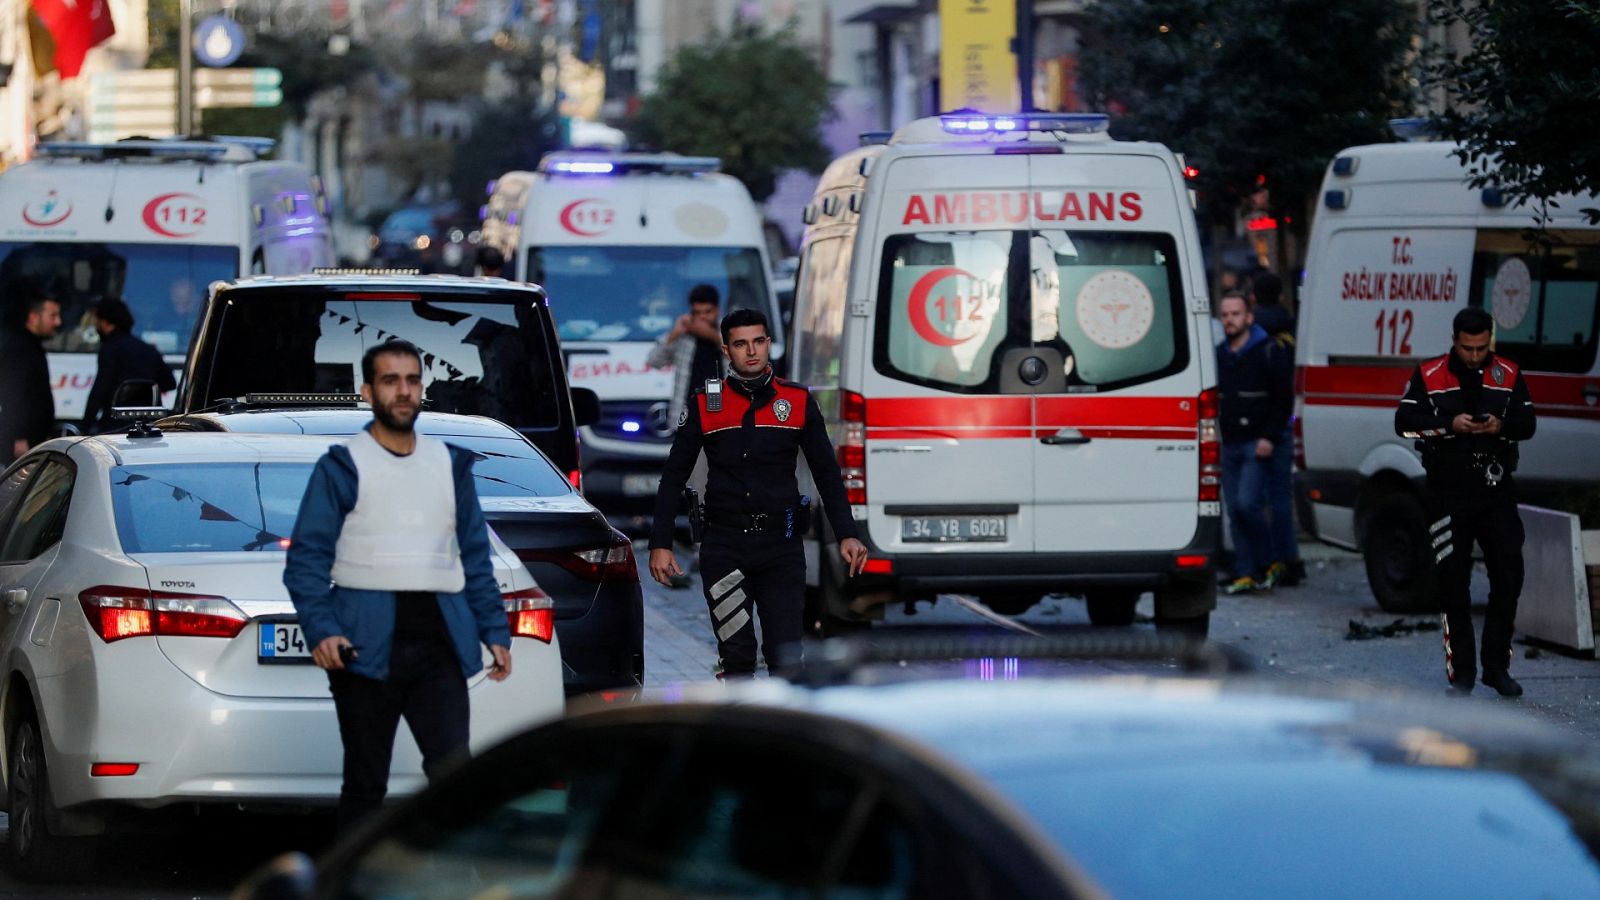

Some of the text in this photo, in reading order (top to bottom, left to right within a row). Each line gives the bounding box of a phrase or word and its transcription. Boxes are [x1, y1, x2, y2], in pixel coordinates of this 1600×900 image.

[161, 206, 206, 225] 112
[575, 208, 616, 225] 112
[902, 191, 1143, 225] AMBULANS
[1392, 236, 1413, 264] T.C.
[1342, 266, 1458, 302] SAĞLIK BAKANLIĞI
[934, 295, 984, 321] 112
[1375, 309, 1414, 356] 112
[911, 519, 1005, 537] 34 YB 6021
[160, 580, 196, 589] TOYOTA
[264, 627, 304, 653] TR 34
